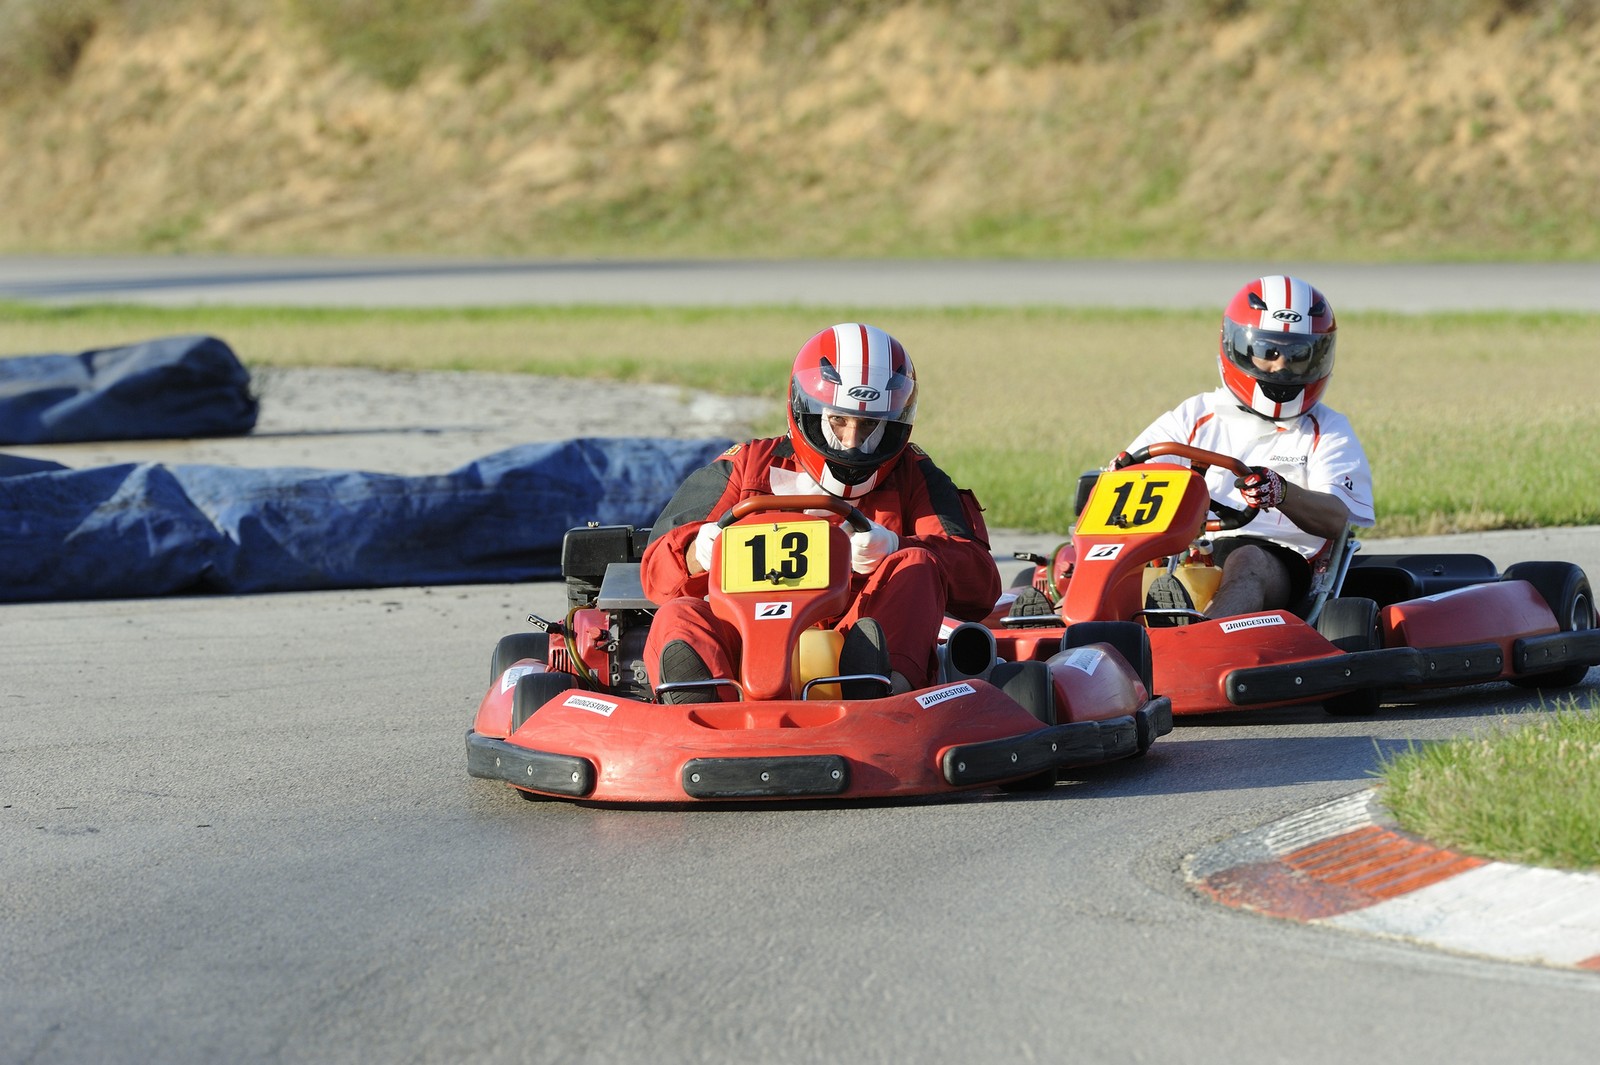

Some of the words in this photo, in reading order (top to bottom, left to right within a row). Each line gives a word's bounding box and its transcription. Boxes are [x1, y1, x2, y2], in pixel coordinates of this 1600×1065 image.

[1105, 482, 1169, 526] 15
[745, 532, 808, 582] 13
[1225, 617, 1280, 631] BRIDGESTONE
[921, 685, 971, 706] BRIDGESTONE
